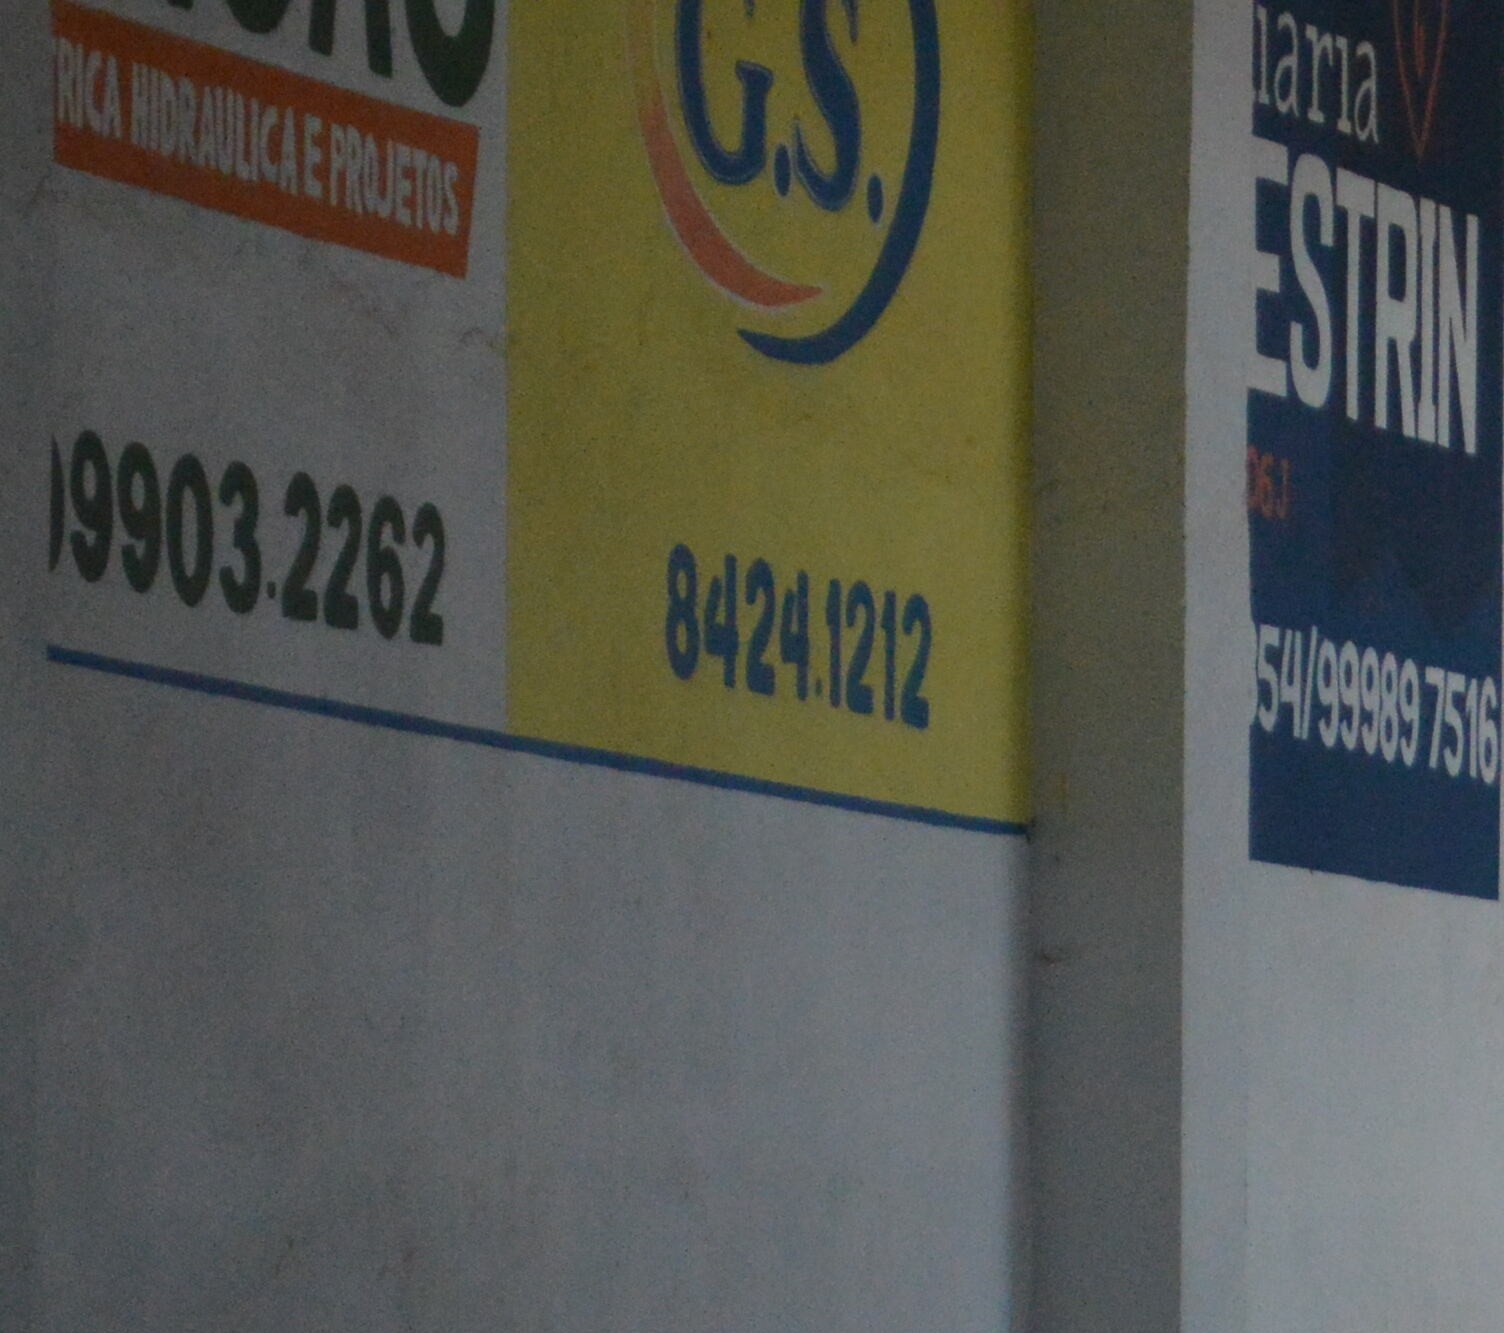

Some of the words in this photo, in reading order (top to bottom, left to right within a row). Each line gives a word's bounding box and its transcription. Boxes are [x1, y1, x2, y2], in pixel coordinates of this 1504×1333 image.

[54, 36, 122, 140] RICA
[304, 114, 324, 198] E
[330, 122, 460, 237] PROJETOS
[50, 430, 446, 646] 9903.2262
[664, 543, 933, 731] 8424.1212
